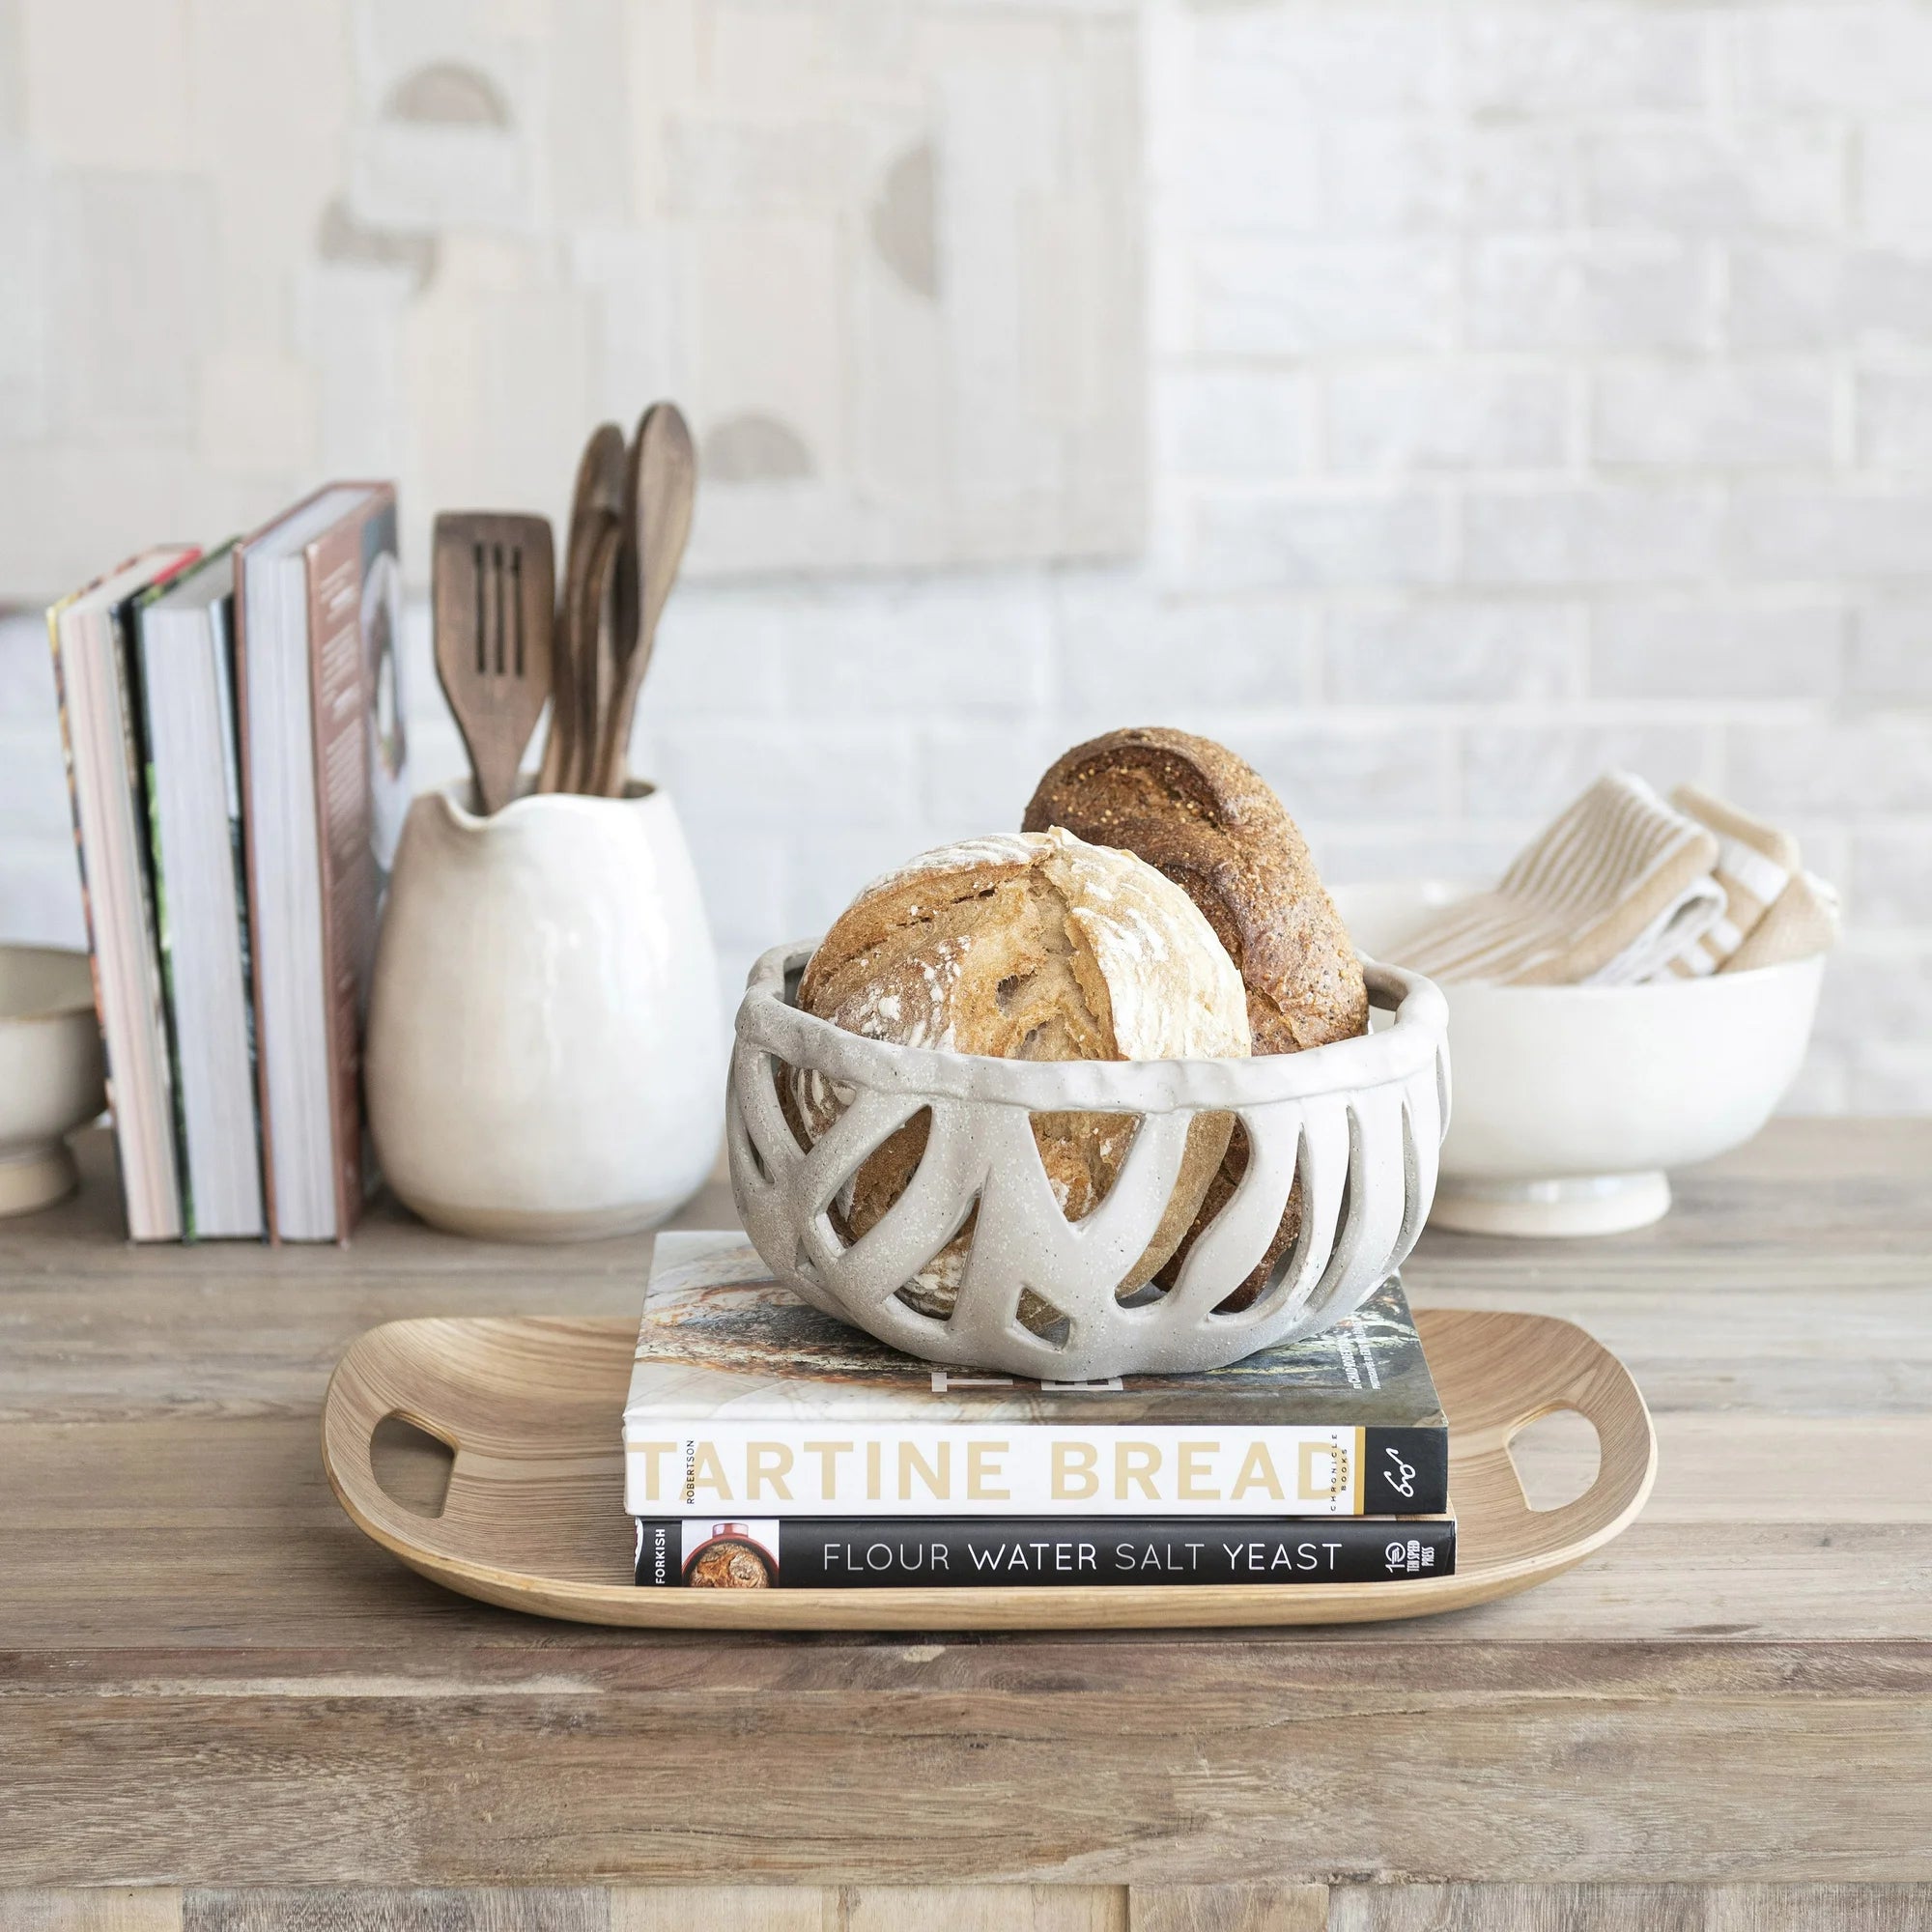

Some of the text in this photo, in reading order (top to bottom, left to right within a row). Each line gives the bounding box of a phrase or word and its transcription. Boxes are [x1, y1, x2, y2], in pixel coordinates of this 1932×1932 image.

[1345, 1367, 1361, 1383] CHAD
[628, 1439, 1350, 1500] TARTINE BREAD
[686, 1439, 696, 1505] ROBERTSON
[1330, 1434, 1339, 1512] CHRONICLE
[1340, 1448, 1349, 1492] BOOKS
[655, 1528, 667, 1585] FORKISH
[824, 1543, 1343, 1572] FLOUR WATER SALT YEAST
[1406, 1540, 1421, 1573] TEN SPEED
[1421, 1546, 1435, 1567] PRESS
